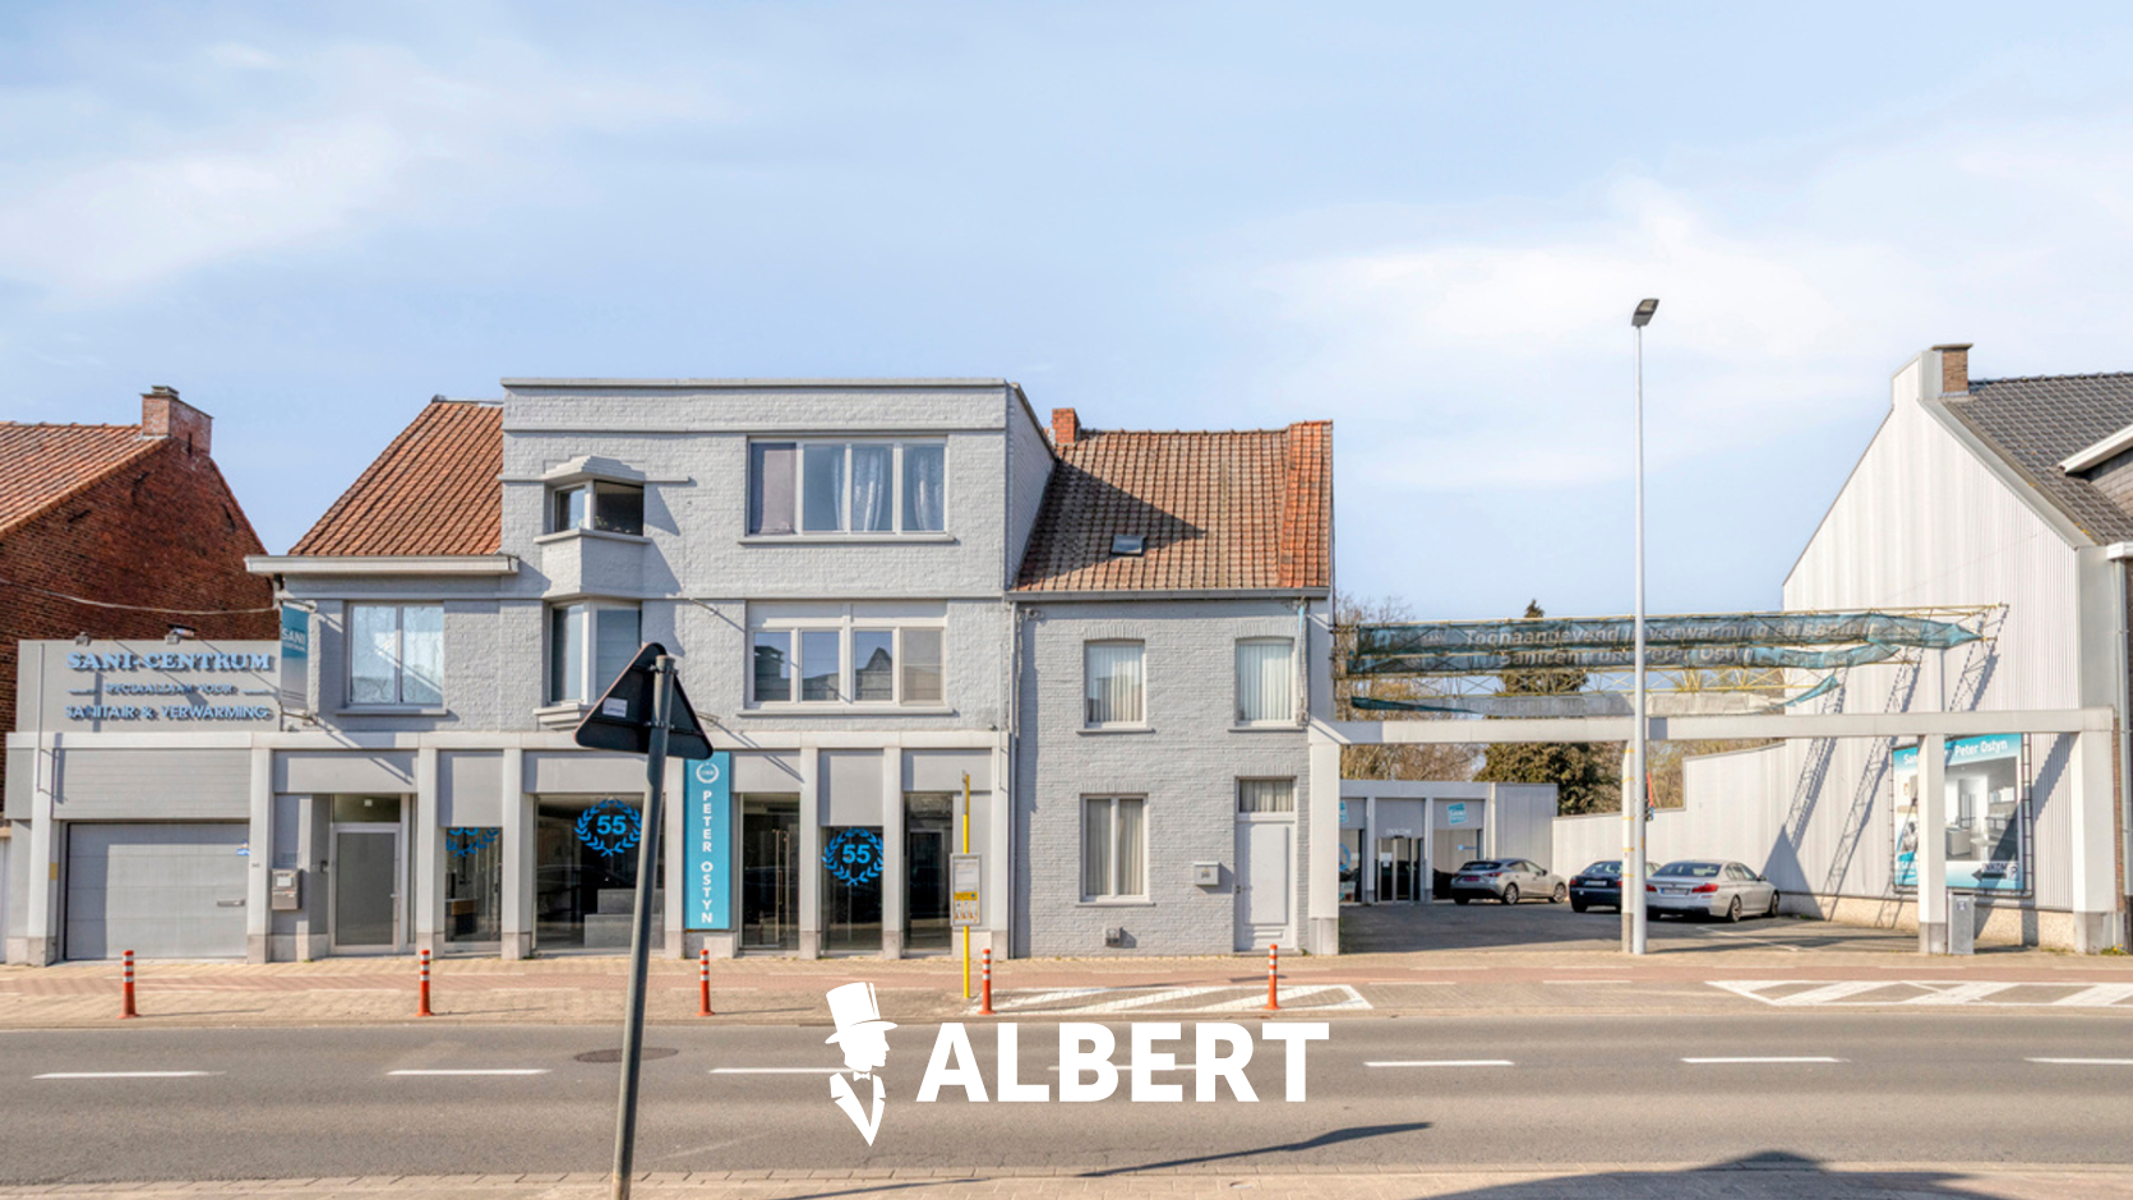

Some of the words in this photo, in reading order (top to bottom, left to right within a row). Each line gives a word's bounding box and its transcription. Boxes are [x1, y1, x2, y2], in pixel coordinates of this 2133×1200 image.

[66, 652, 272, 671] SANI-CENTRUM
[65, 704, 136, 719] SANITAIR
[161, 704, 271, 719] VERWARMING
[1955, 743, 1978, 757] Peter
[1980, 739, 2009, 754] Ostyn
[597, 815, 627, 835] 55
[702, 789, 713, 853] PETER
[842, 843, 871, 864] 55
[700, 861, 714, 924] OSTYN
